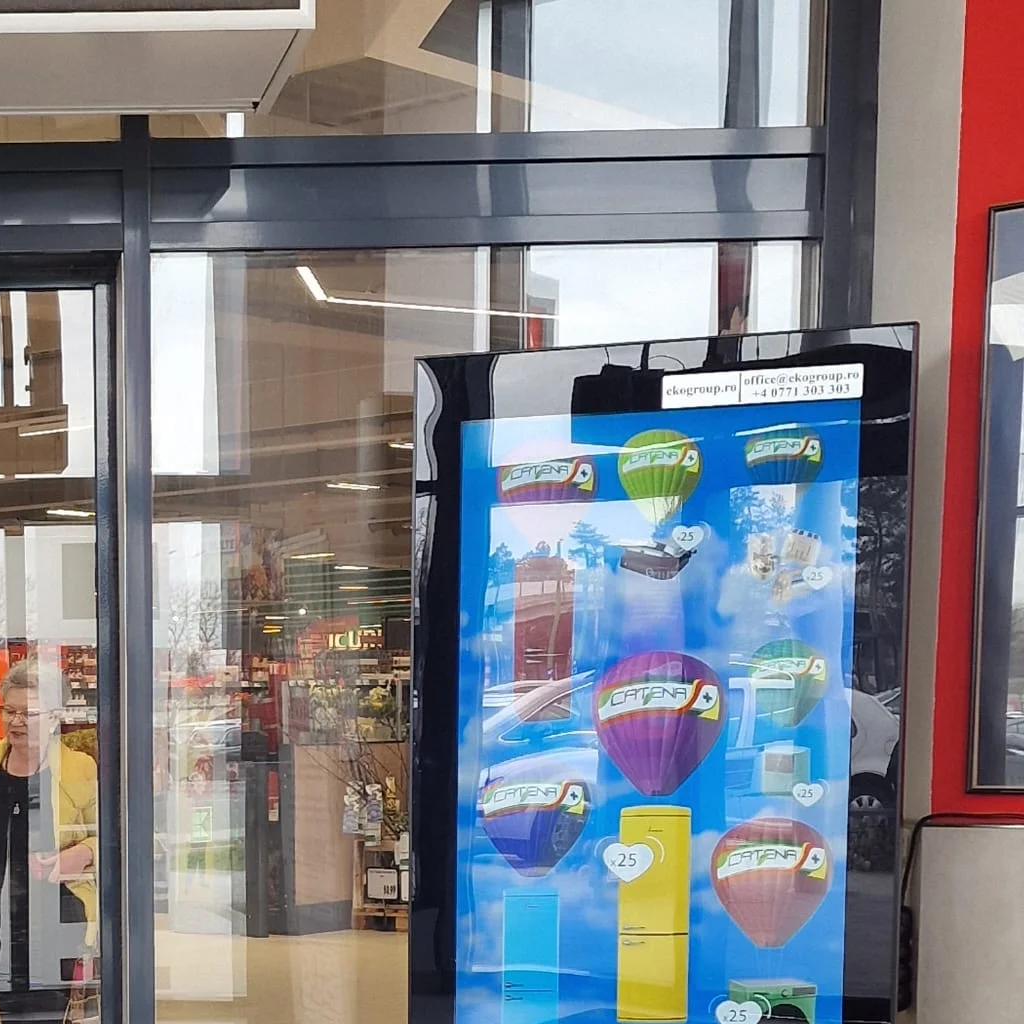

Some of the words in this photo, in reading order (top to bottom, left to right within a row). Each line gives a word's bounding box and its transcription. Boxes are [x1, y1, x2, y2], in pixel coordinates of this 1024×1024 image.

[744, 371, 860, 386] office@ekogroup.ro
[666, 384, 737, 396] ekogroup.ro
[752, 388, 766, 398] +4
[771, 386, 799, 398] 0771
[803, 385, 825, 396] 303
[830, 384, 850, 395] 303
[753, 441, 801, 453] CATENA
[628, 451, 678, 465] CATENA
[510, 464, 569, 481] CATENA
[610, 686, 687, 706] CATENA
[493, 787, 558, 802] CATENA
[609, 853, 637, 867] x25
[727, 849, 797, 867] CATENA
[723, 1009, 747, 1022] x25
